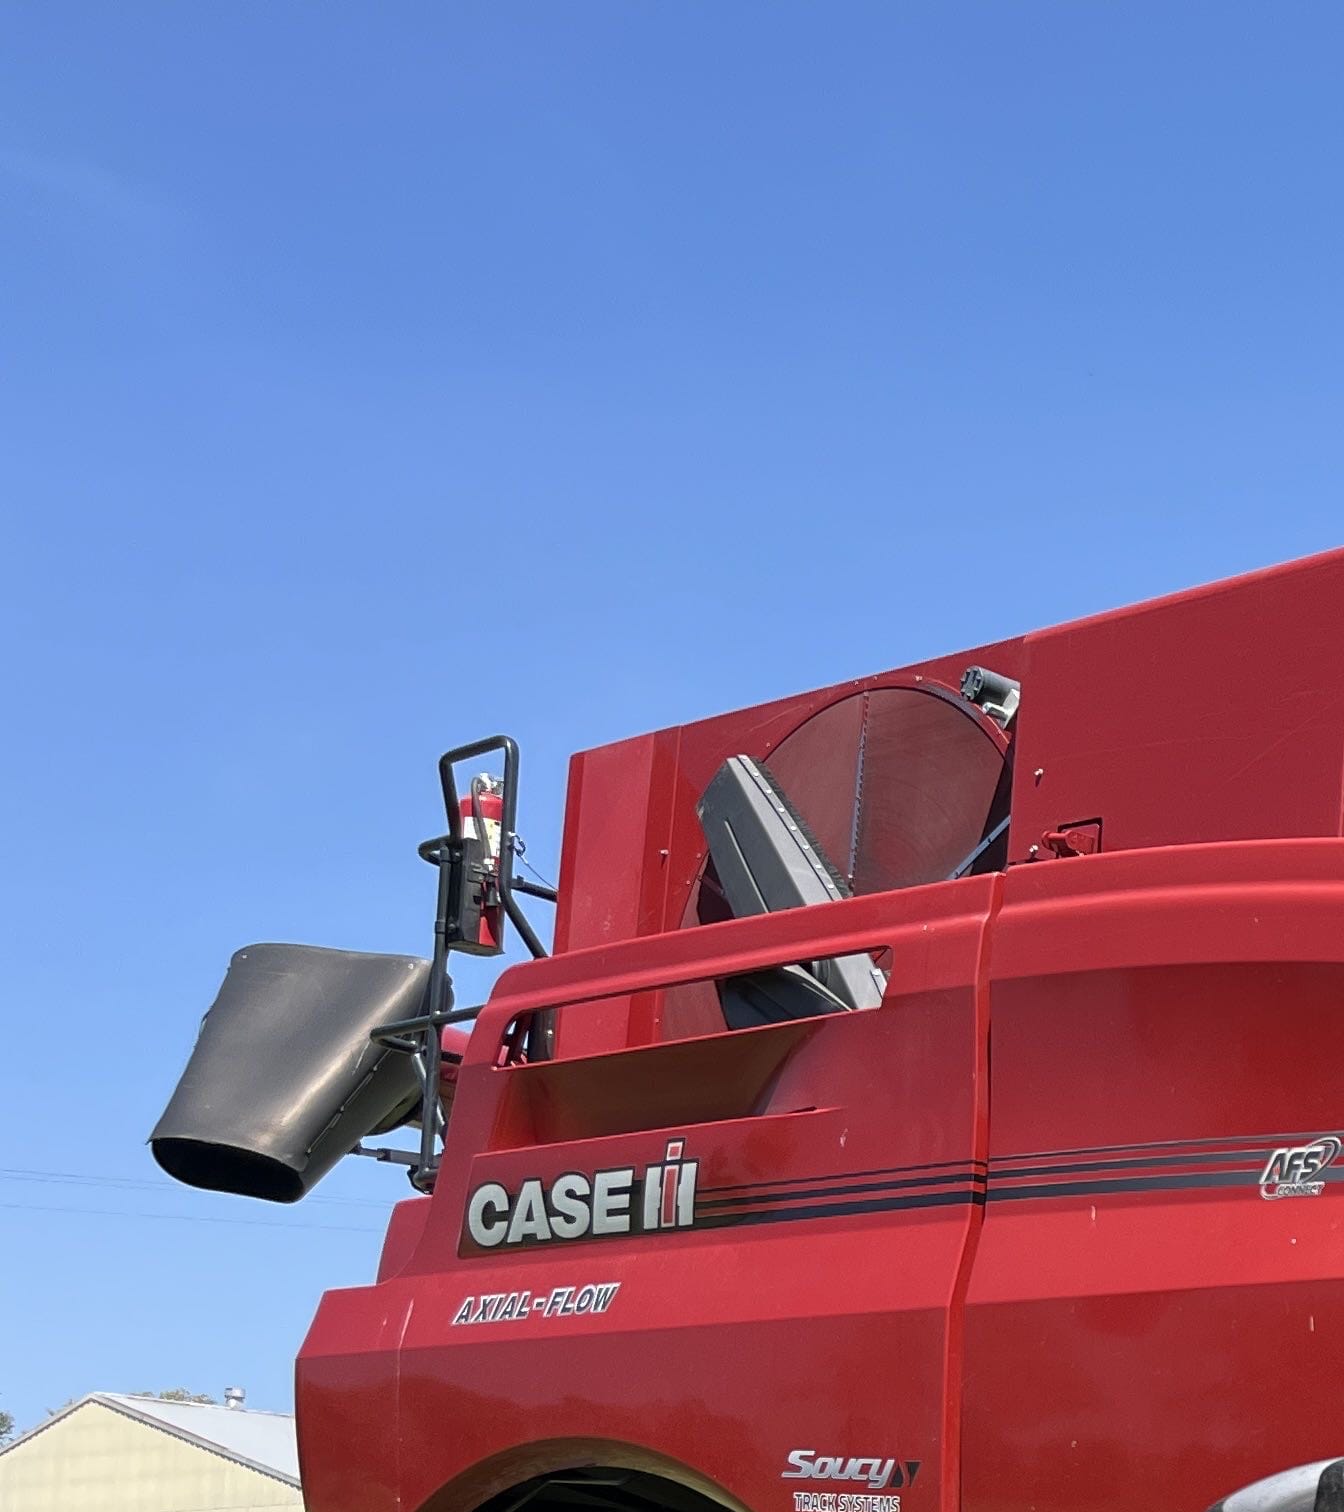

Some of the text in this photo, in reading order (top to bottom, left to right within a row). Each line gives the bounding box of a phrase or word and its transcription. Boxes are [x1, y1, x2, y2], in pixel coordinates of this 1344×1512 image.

[1259, 1146, 1327, 1185] AFS
[468, 1139, 698, 1248] CASE IH
[451, 1282, 621, 1326] AXIAL-FLOW
[781, 1450, 896, 1489] Soucy
[793, 1492, 837, 1512] TRACK
